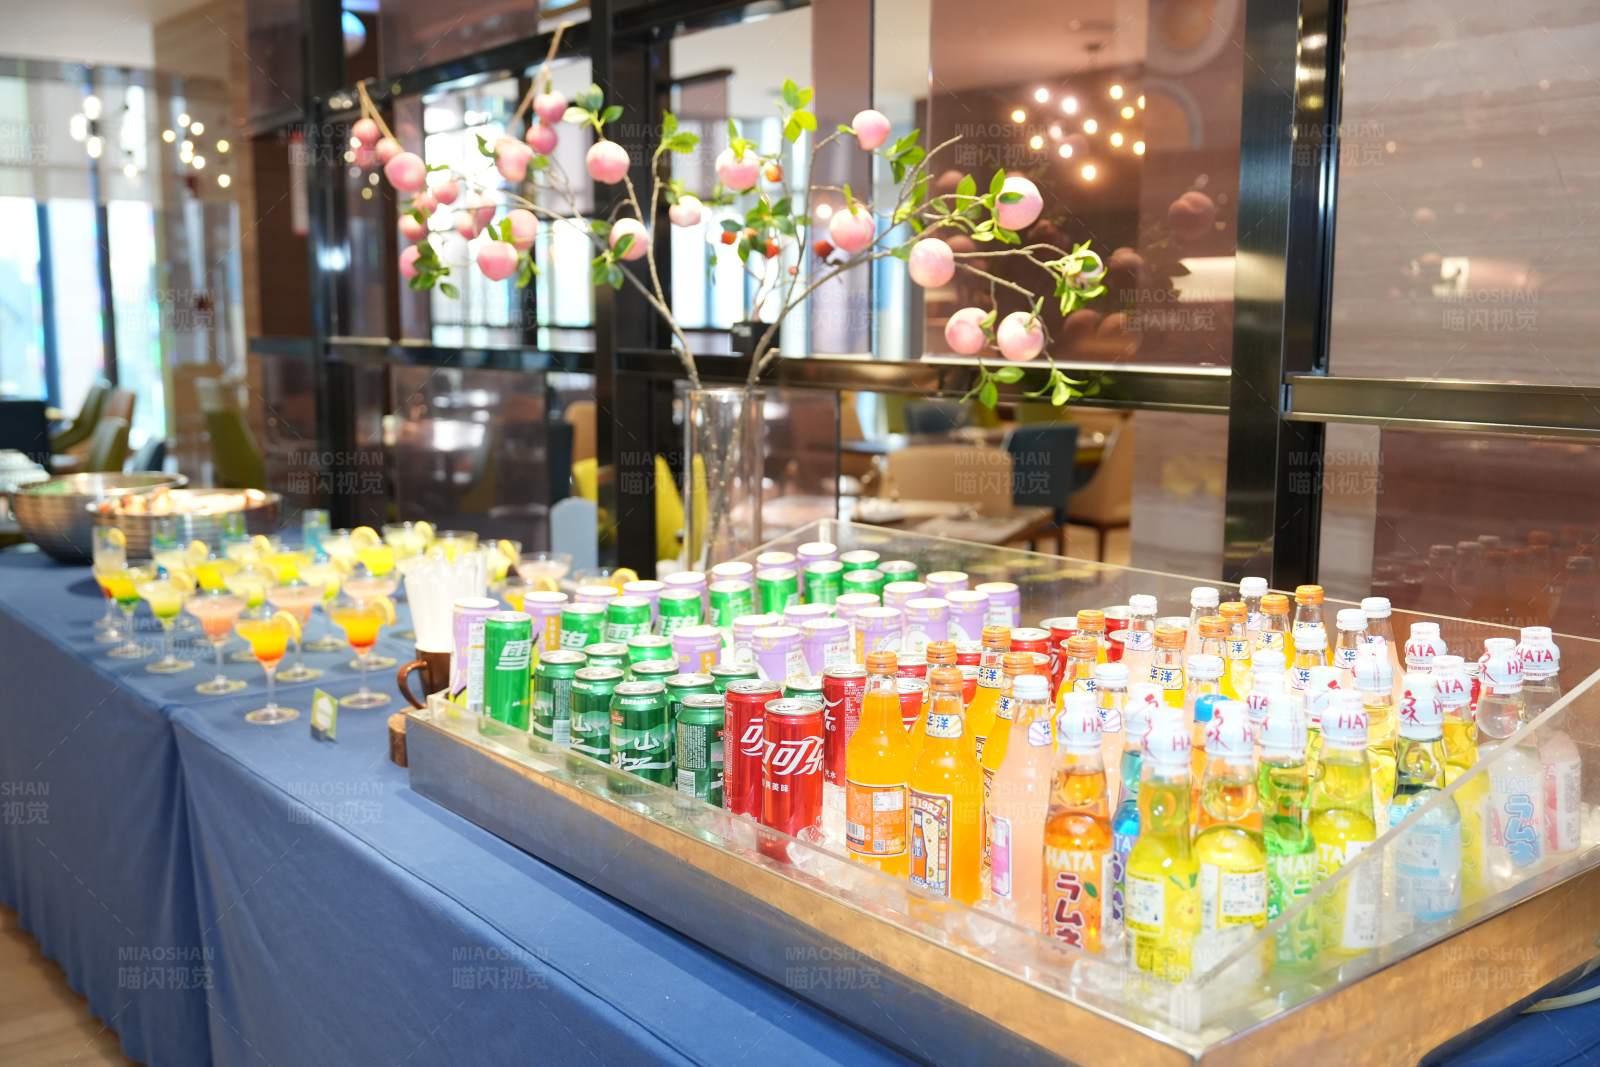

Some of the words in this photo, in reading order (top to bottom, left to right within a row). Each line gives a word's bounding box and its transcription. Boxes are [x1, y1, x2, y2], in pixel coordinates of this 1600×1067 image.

[1232, 642, 1243, 654] 洋
[1344, 651, 1356, 662] 华
[1150, 668, 1173, 683] 华洋
[1299, 671, 1310, 683] 华
[928, 714, 949, 730] 华洋
